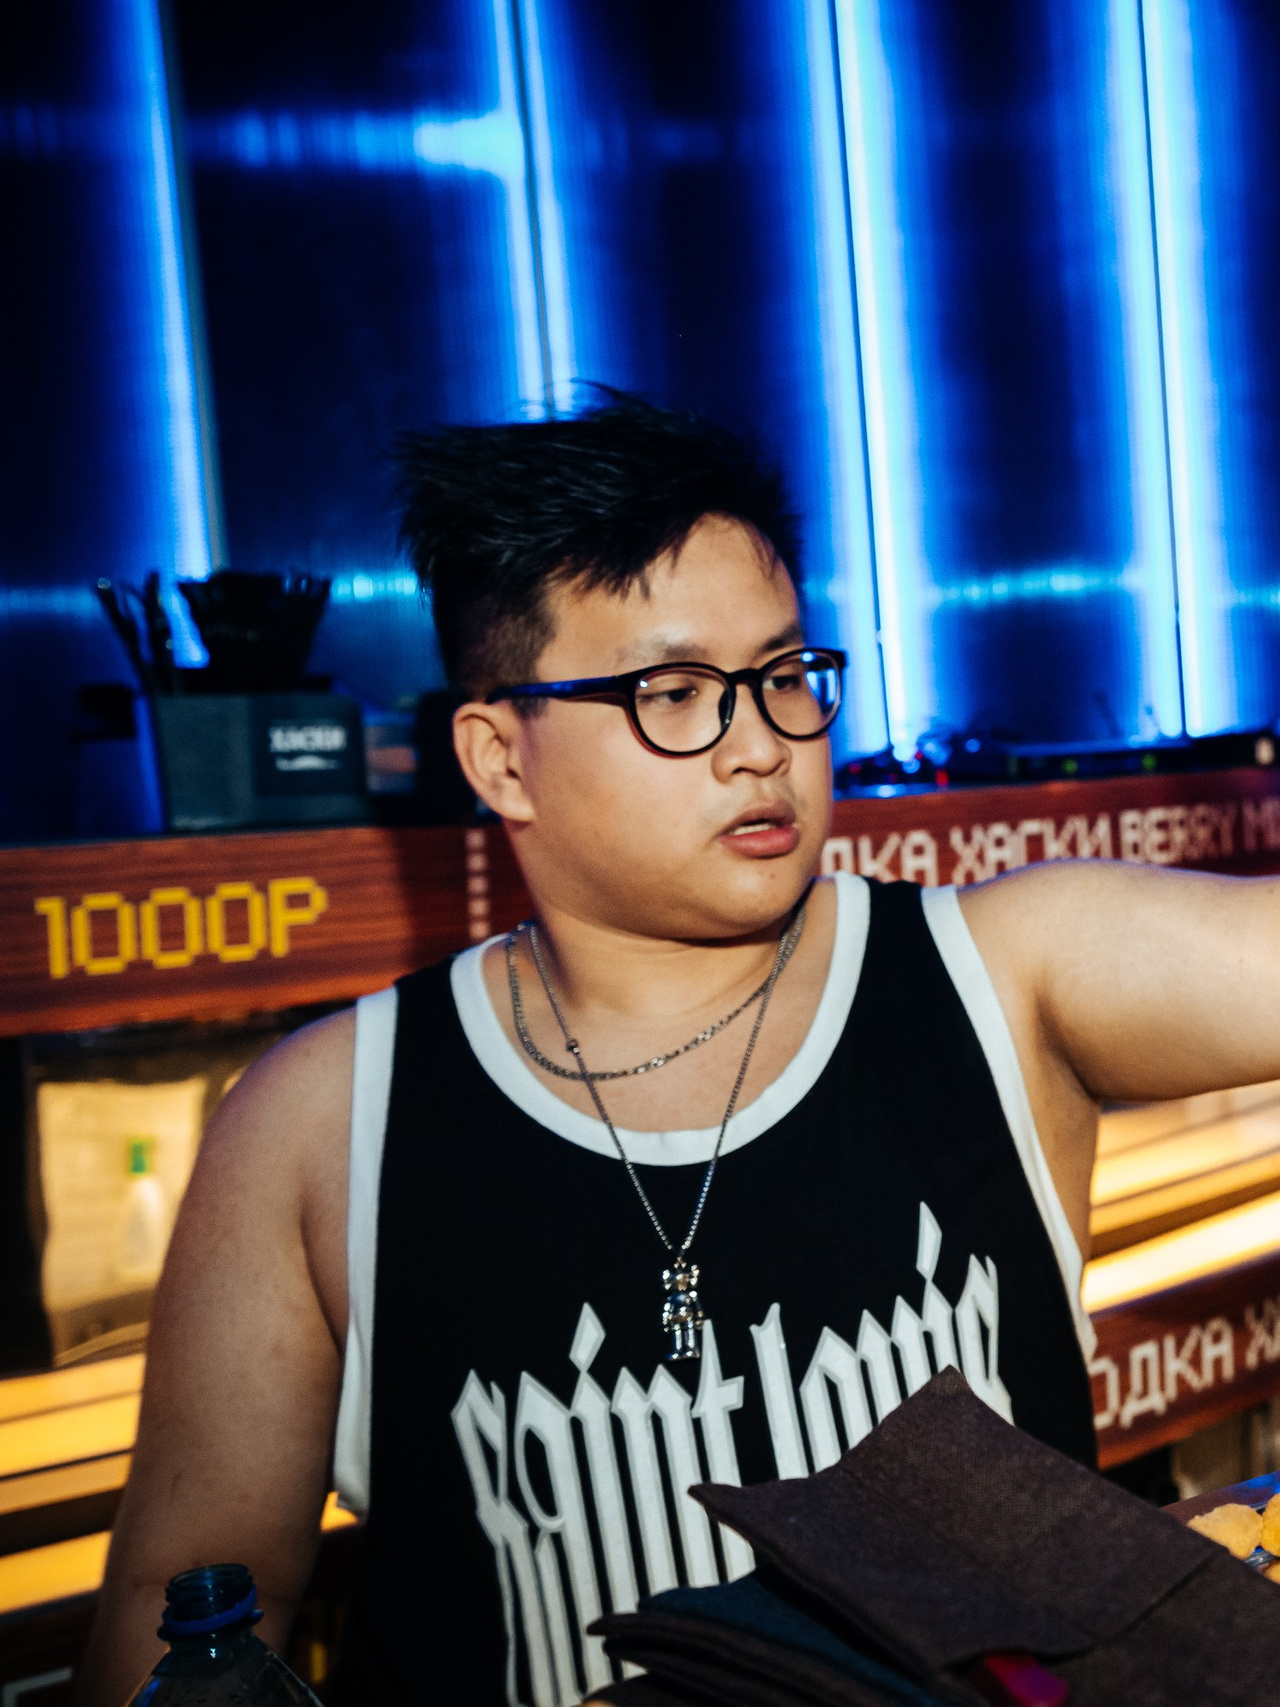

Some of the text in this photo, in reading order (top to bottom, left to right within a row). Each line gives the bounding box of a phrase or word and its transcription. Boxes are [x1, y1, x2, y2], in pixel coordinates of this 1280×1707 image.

[821, 829, 940, 888] ДКА
[1119, 799, 1238, 866] BERRY
[1087, 1316, 1235, 1430] ОДКА
